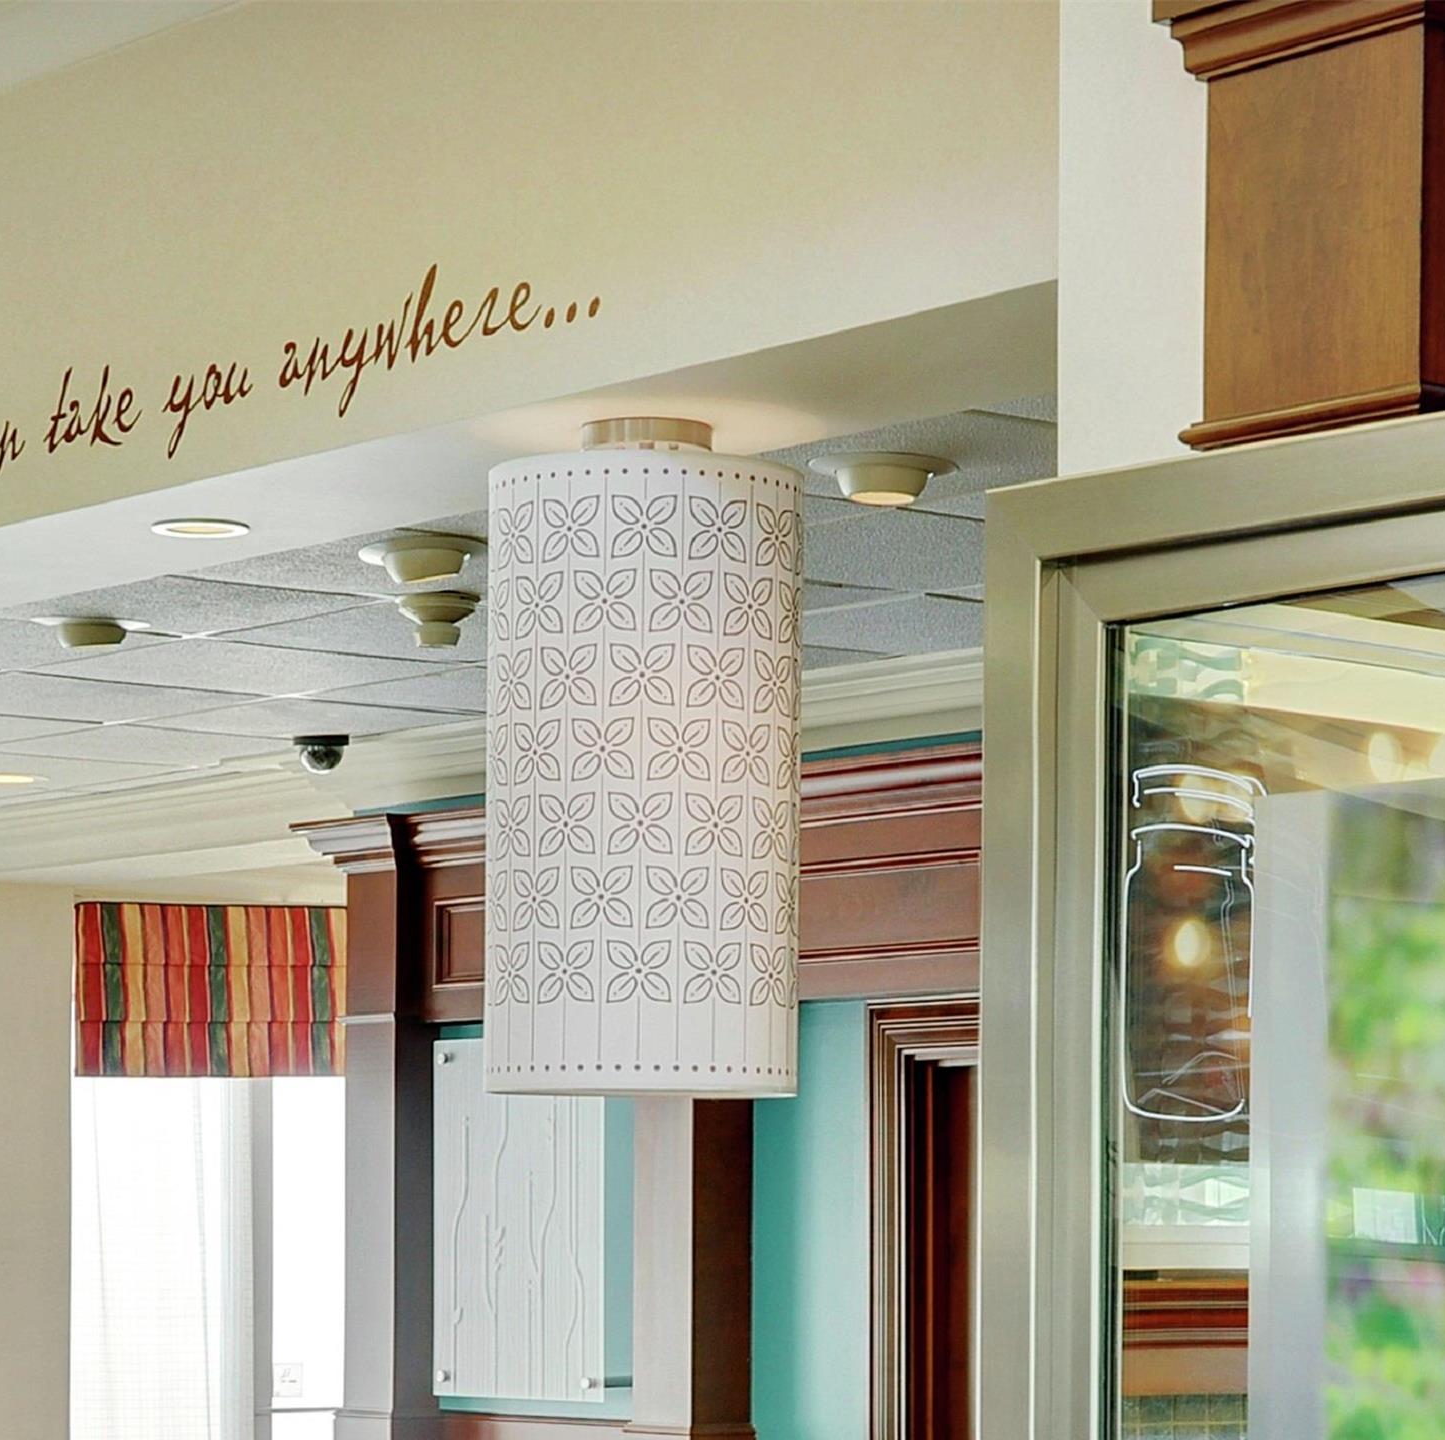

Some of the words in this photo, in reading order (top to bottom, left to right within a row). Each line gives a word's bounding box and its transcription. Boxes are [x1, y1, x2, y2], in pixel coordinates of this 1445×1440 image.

[42, 364, 144, 456] take
[161, 360, 255, 460] you
[277, 263, 601, 419] anywhere...
